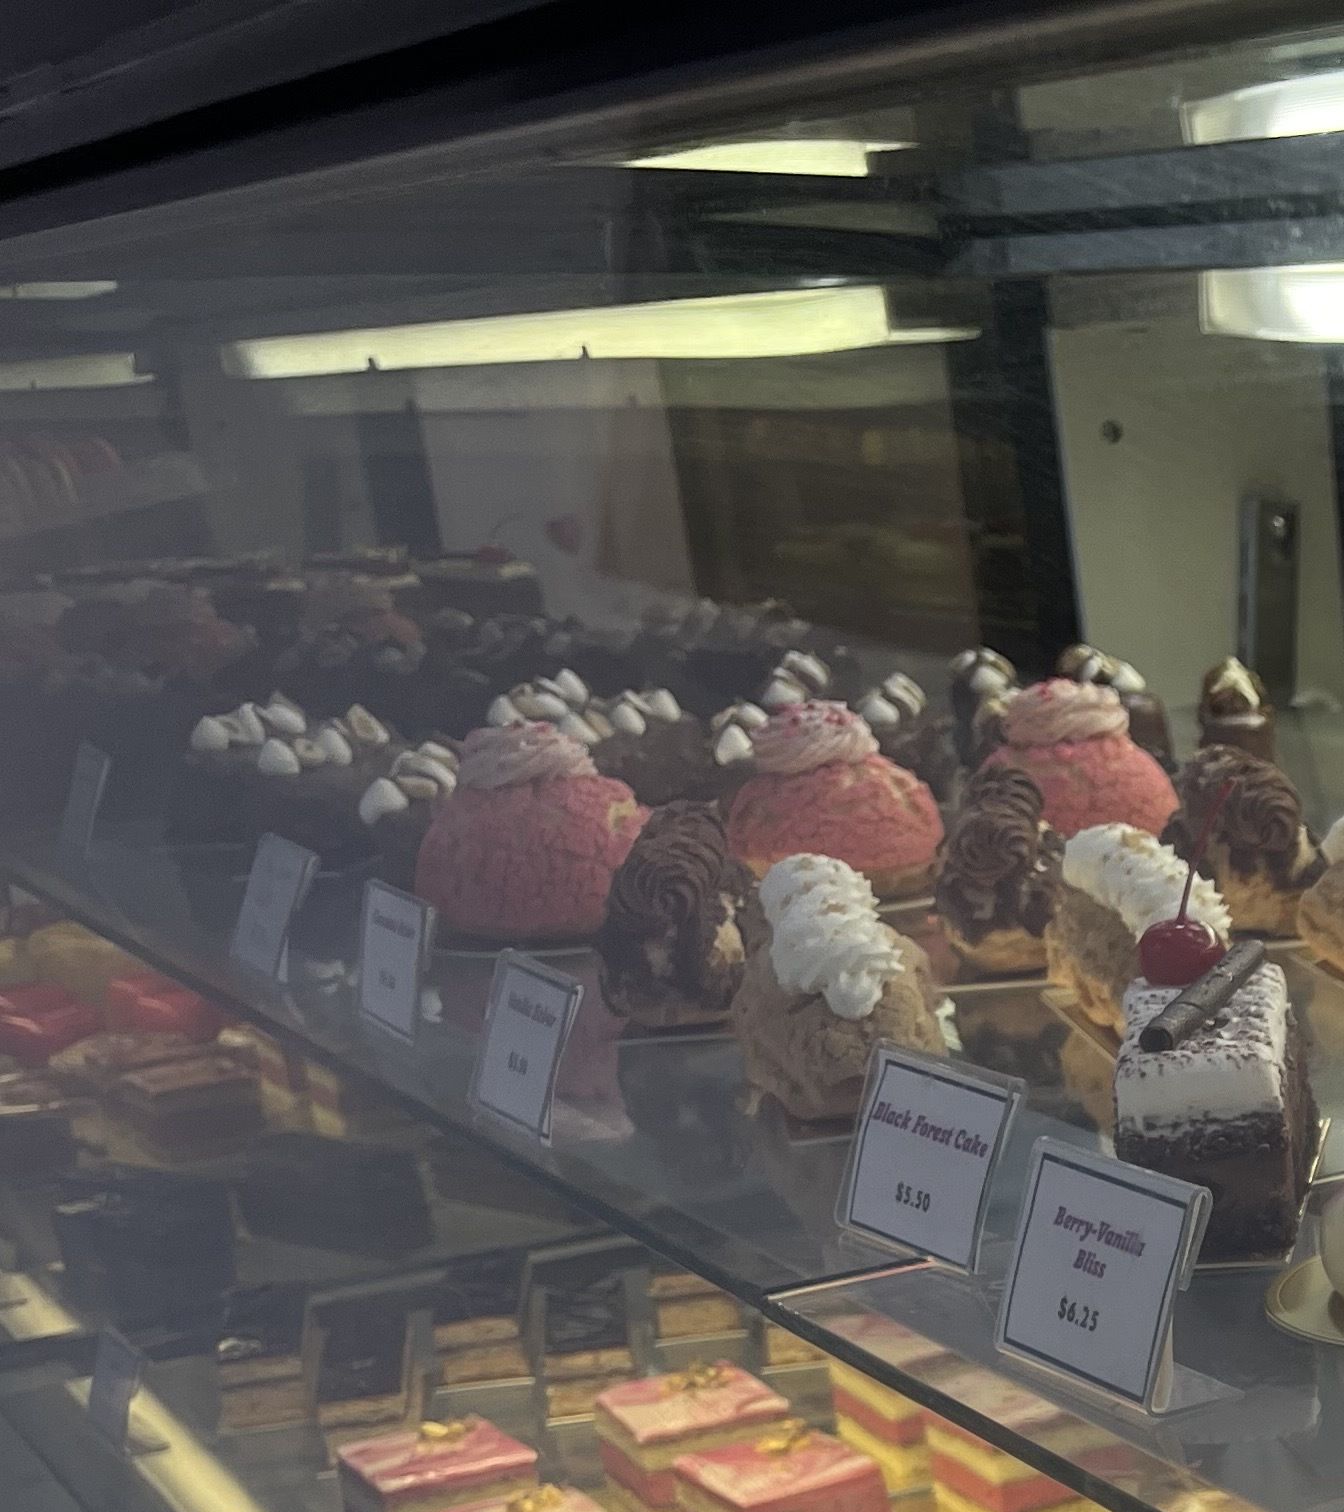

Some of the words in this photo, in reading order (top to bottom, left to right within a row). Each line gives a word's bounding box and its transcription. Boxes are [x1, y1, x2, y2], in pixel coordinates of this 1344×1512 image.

[873, 1101, 911, 1131] Black
[912, 1115, 952, 1146] Forest
[954, 1129, 989, 1159] Cake
[895, 1182, 931, 1213] $5.50
[1072, 1248, 1106, 1279] Bliss
[1057, 1295, 1099, 1332] $6.25
